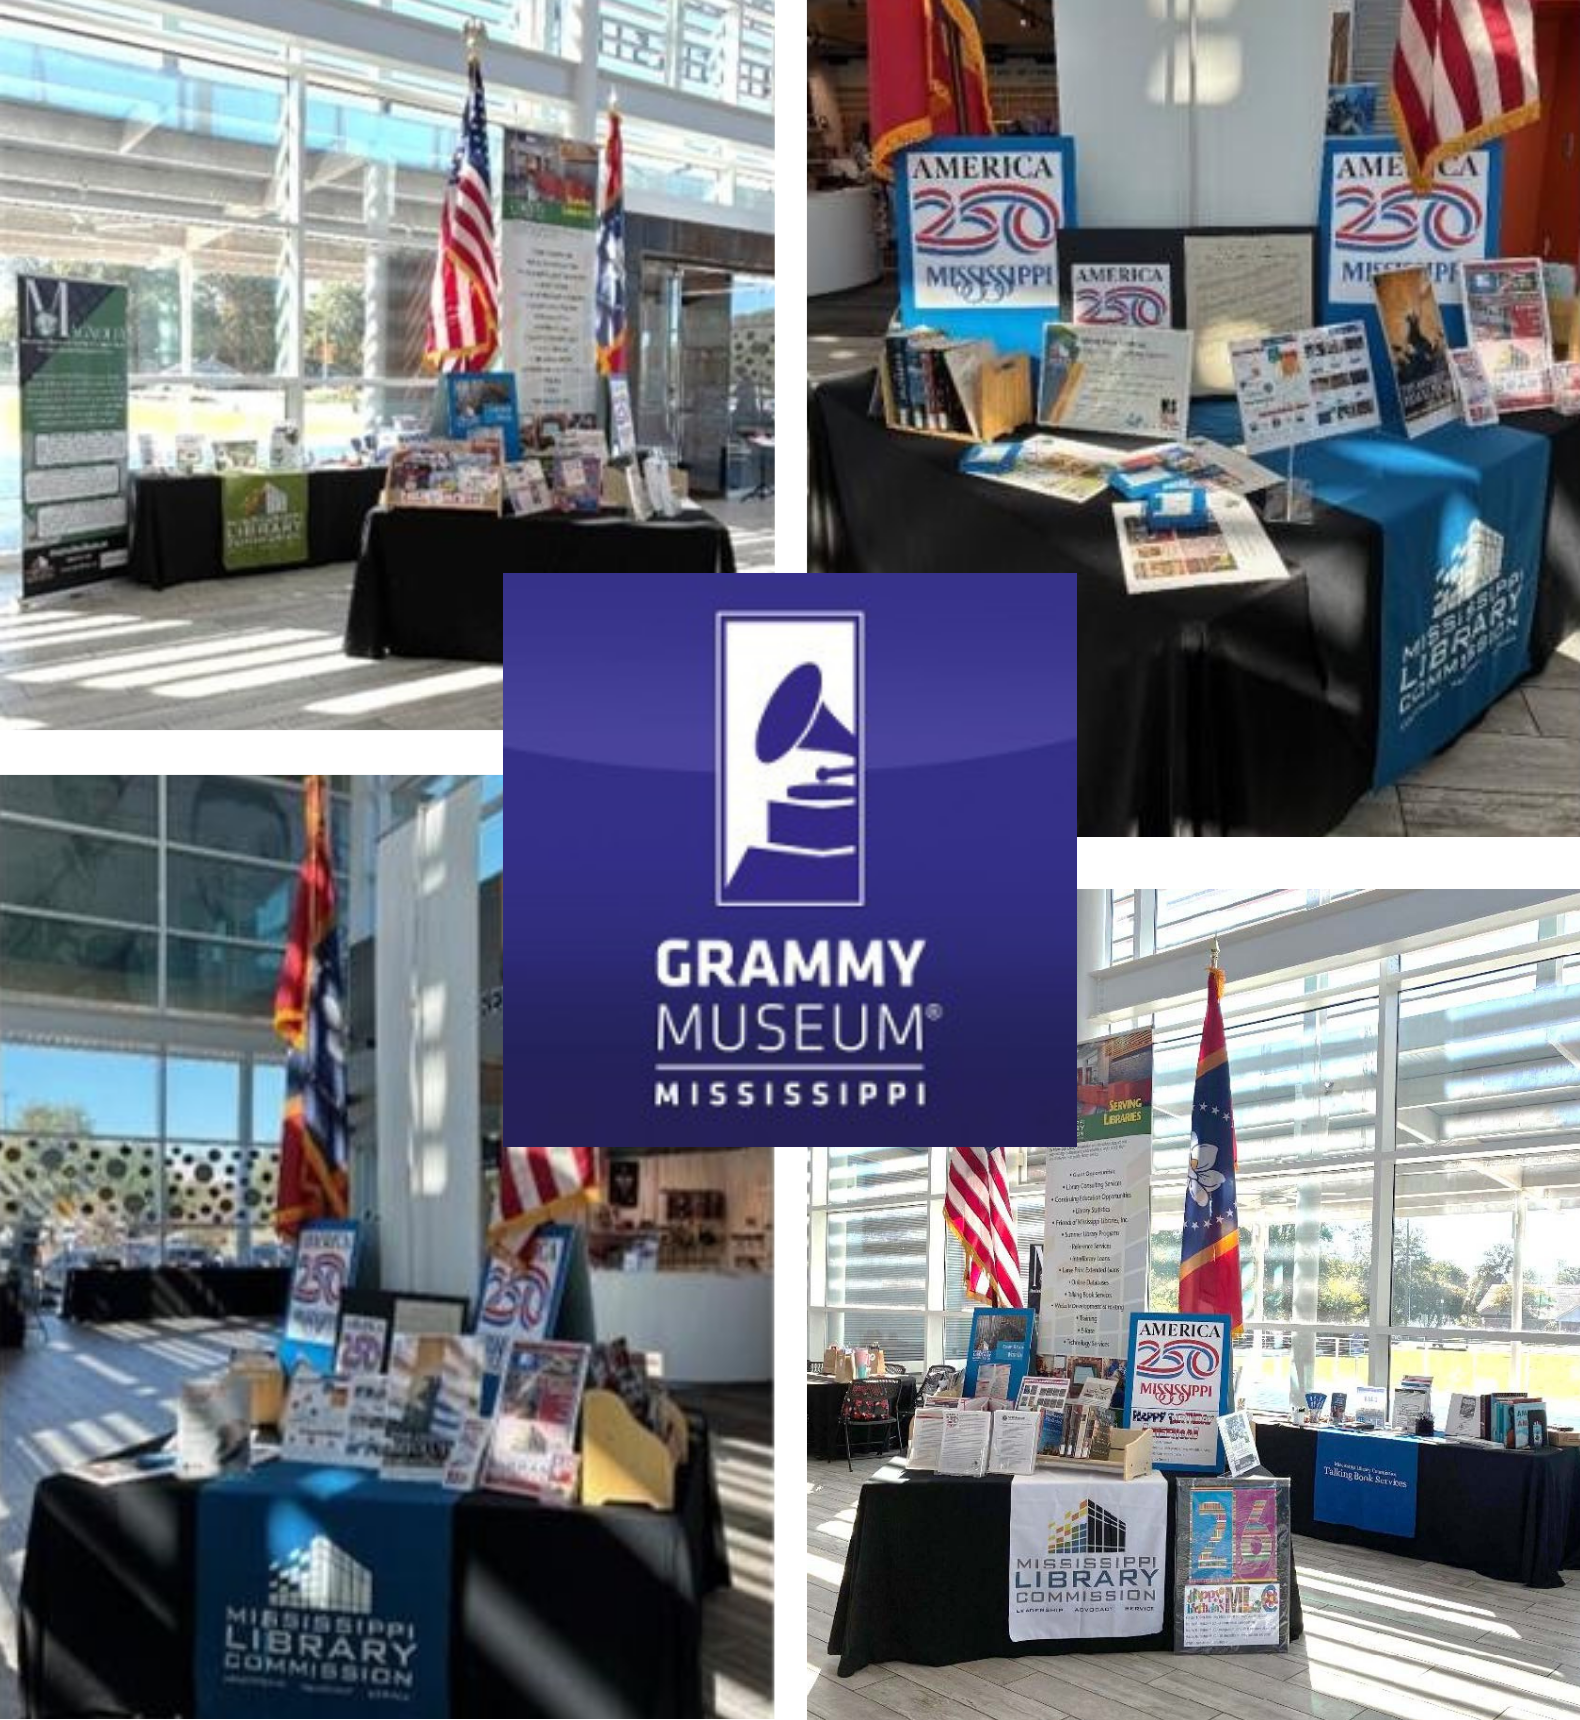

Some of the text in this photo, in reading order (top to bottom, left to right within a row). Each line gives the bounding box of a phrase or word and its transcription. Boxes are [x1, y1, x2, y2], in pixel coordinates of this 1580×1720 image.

[912, 156, 1053, 180] AMERICA
[1337, 155, 1479, 179] AMECA
[914, 183, 1060, 256] 250
[1336, 181, 1483, 252] 250
[926, 264, 1052, 304] MISSISSIPPI
[1076, 267, 1164, 282] AMERICA
[1075, 285, 1168, 326] 250
[1400, 586, 1522, 694] LIBRARY
[1109, 1098, 1142, 1112] SERVING
[1103, 1112, 1142, 1126] LIBRARIES
[1139, 1322, 1221, 1338] AMERICA
[1136, 1339, 1220, 1380] 250
[1140, 1382, 1213, 1406] MISSISSIPPI
[1324, 1466, 1407, 1488] Talking Book Services
[1016, 1556, 1157, 1569] MISSISSIPPI
[1015, 1568, 1160, 1589] LIBRARY
[1016, 1589, 1156, 1603] COMMISSION
[225, 1605, 415, 1640] MISSISSIPPI
[224, 1624, 418, 1667] LIBRARY
[224, 1652, 414, 1687] COMMISSION
